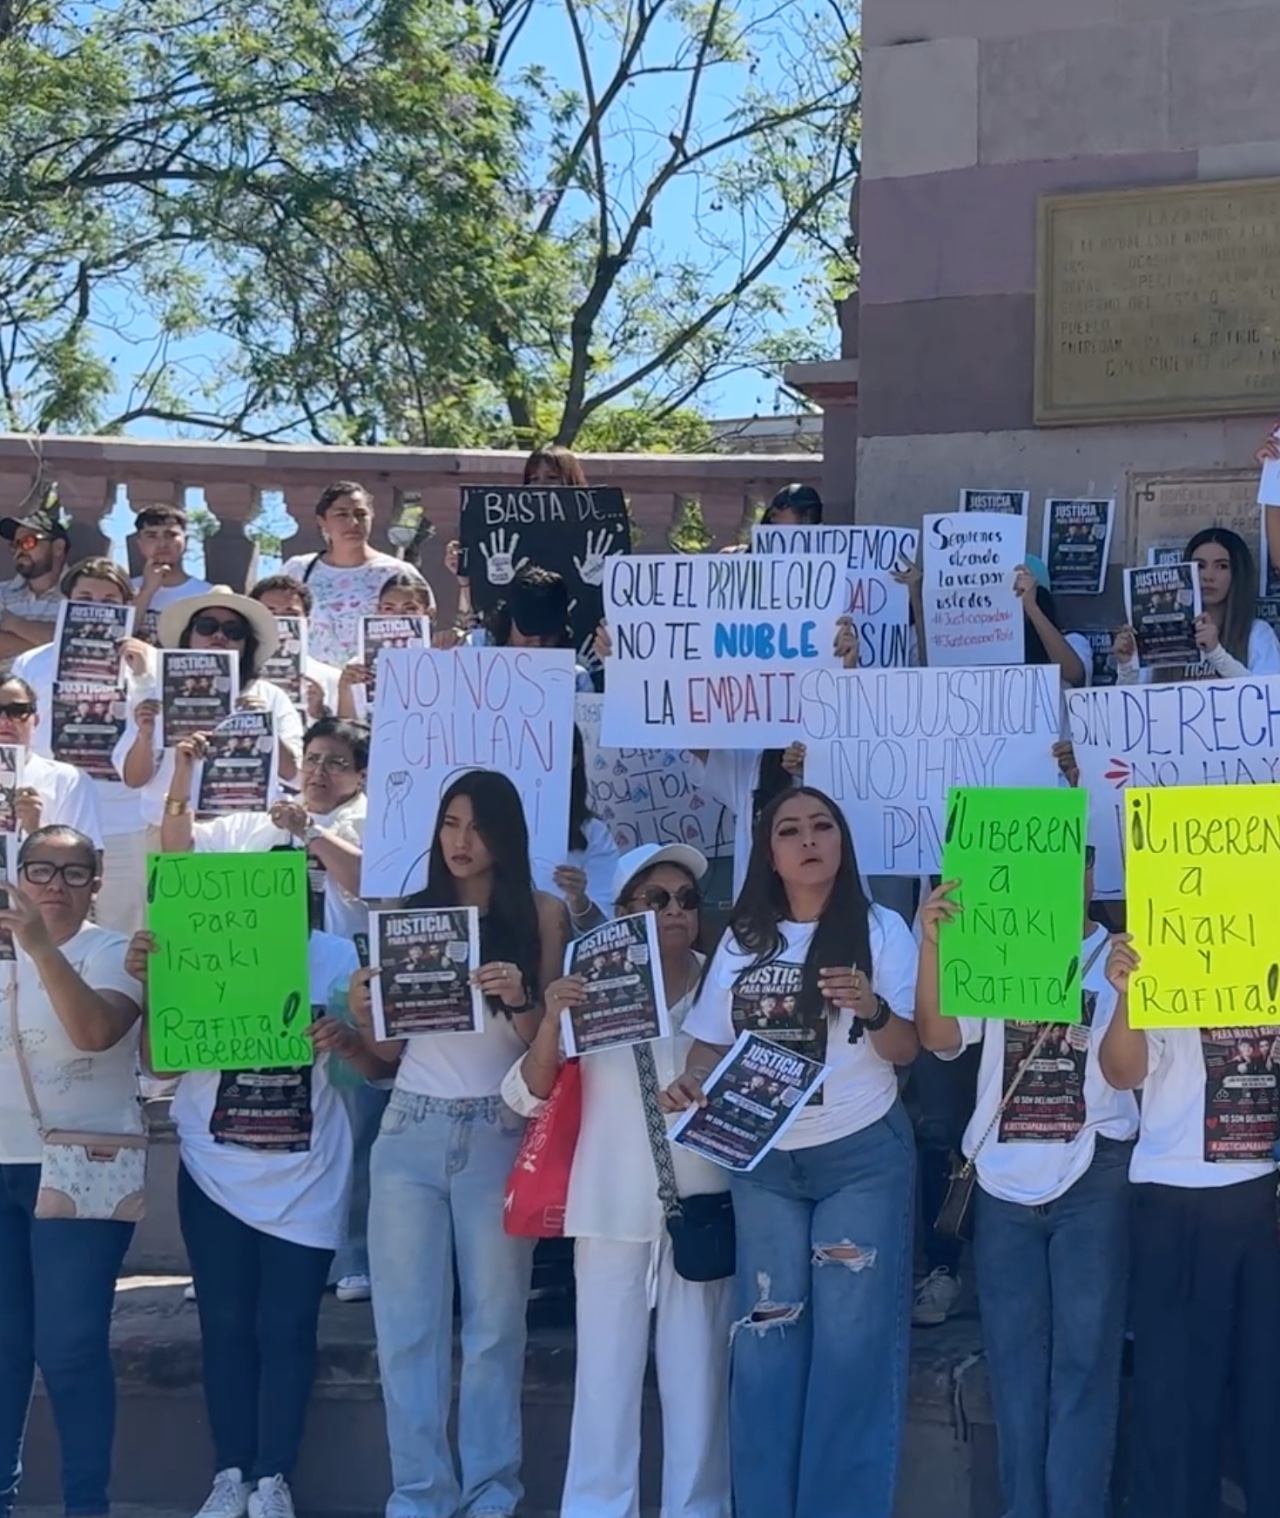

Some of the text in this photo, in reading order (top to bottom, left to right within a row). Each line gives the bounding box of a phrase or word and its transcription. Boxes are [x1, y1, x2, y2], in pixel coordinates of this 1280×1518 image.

[484, 491, 565, 524] BASTA
[970, 496, 1011, 508] JUSTICIA
[1055, 504, 1097, 518] JUSTICIA
[610, 561, 836, 610] QUE EL PRIVILEGIO
[1135, 569, 1179, 587] JUSTICIA
[70, 605, 116, 618] JUSTICIA
[367, 620, 411, 633] JUSTICIA
[617, 621, 819, 661] NO TE NUBLE
[167, 657, 217, 670] JUSTICIA
[381, 651, 545, 718] NO NOS
[644, 679, 674, 725] LA
[687, 672, 801, 725] EMPATI
[801, 667, 1060, 739] SIN JUSTICIA
[1067, 692, 1111, 748] SIN
[401, 711, 553, 772] CALLAN
[831, 740, 907, 800] NO
[1130, 760, 1180, 787] NO
[385, 915, 451, 936] JUSTICIA
[577, 922, 630, 953] JUSTICIA
[744, 1044, 805, 1078] JUSTICIA
